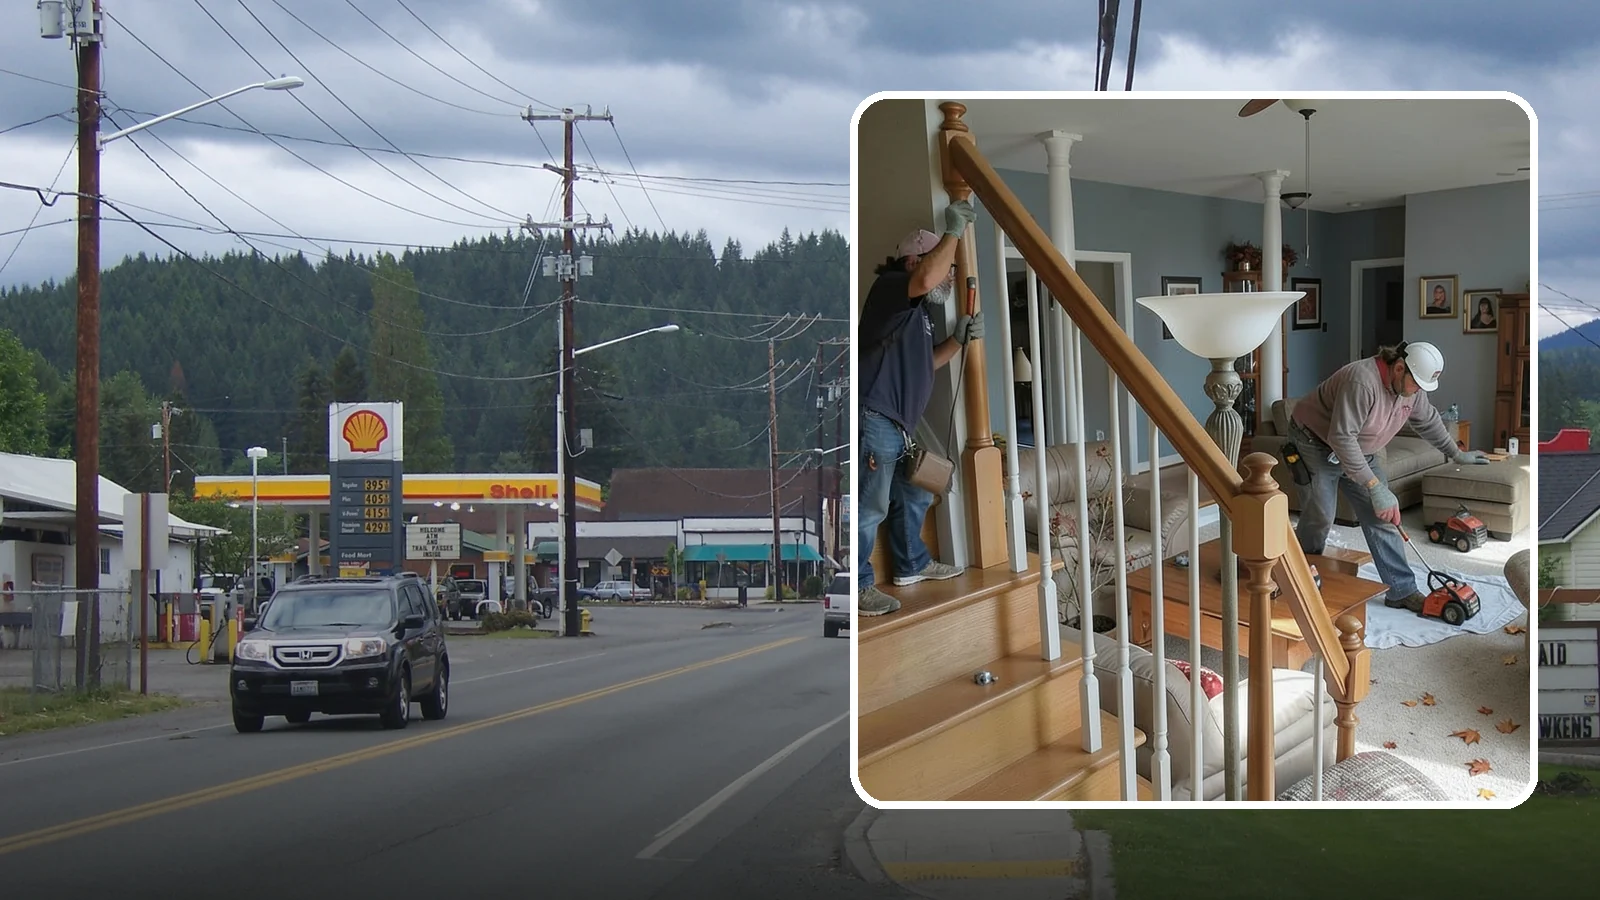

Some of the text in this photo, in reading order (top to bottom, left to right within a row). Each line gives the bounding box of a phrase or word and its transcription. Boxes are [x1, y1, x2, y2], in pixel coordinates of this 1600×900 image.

[366, 480, 383, 490] 395
[490, 484, 547, 499] Shell
[366, 494, 383, 504] 405
[366, 508, 383, 518] 415
[366, 522, 383, 532] 429
[1538, 643, 1567, 665] AID
